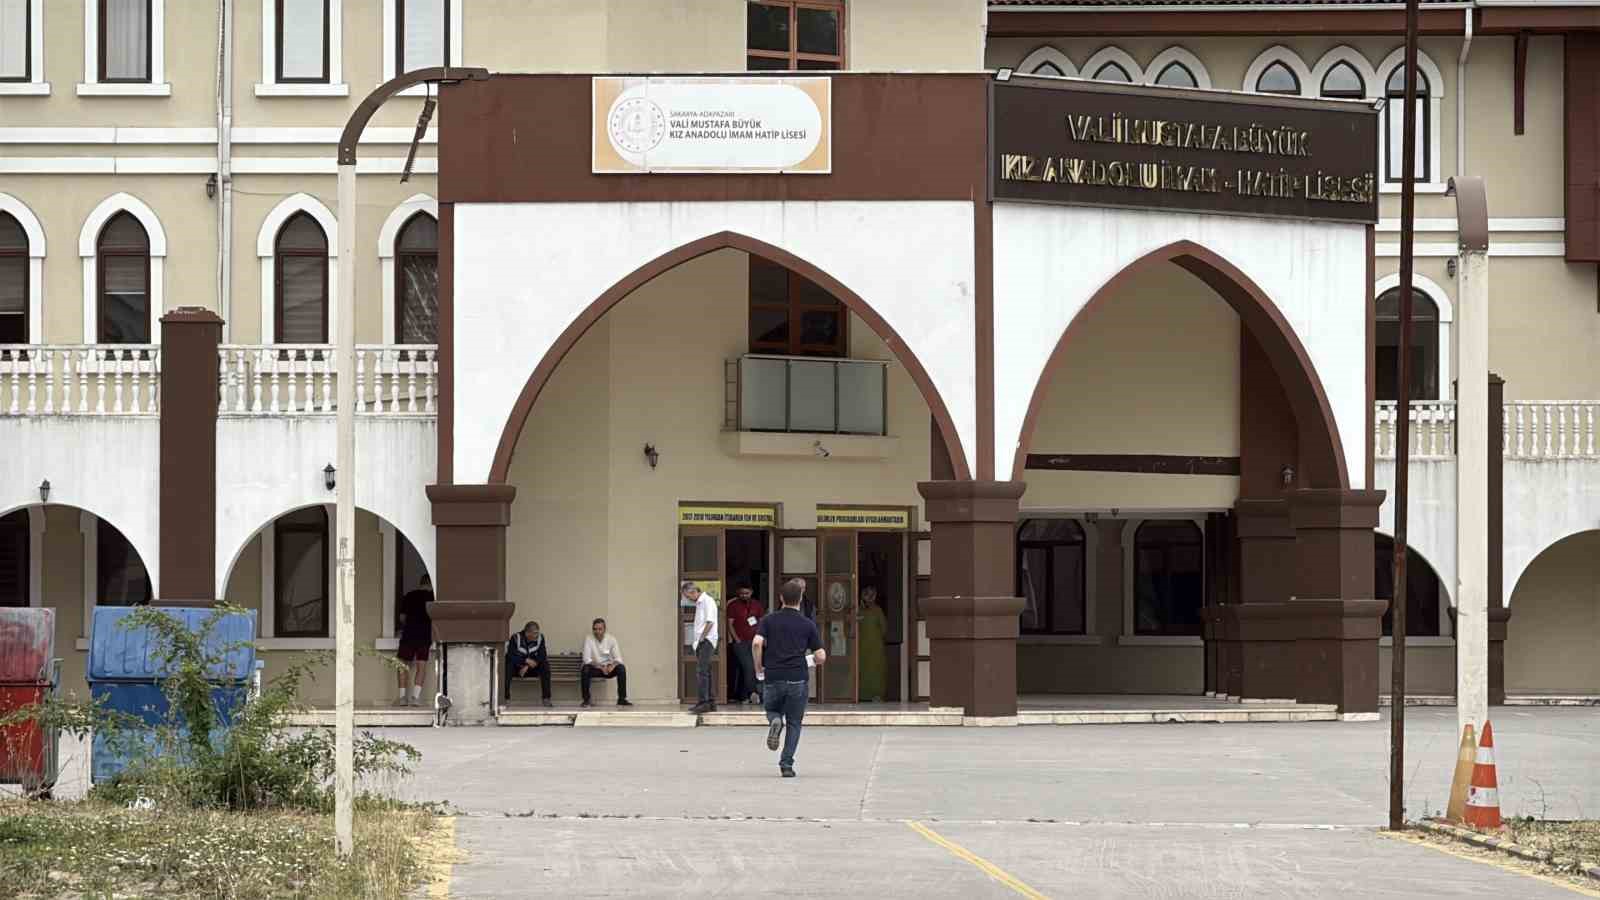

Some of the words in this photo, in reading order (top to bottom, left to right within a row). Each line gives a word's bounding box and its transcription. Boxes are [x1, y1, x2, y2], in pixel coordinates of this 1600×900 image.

[670, 118, 689, 128] VALİ
[691, 120, 730, 128] MUSTAFA
[732, 118, 762, 128] BÜYÜK
[669, 130, 683, 139] KIZ
[685, 130, 727, 139] ANADOLU
[728, 129, 753, 139] İMAM
[781, 129, 806, 140] LİSESİ
